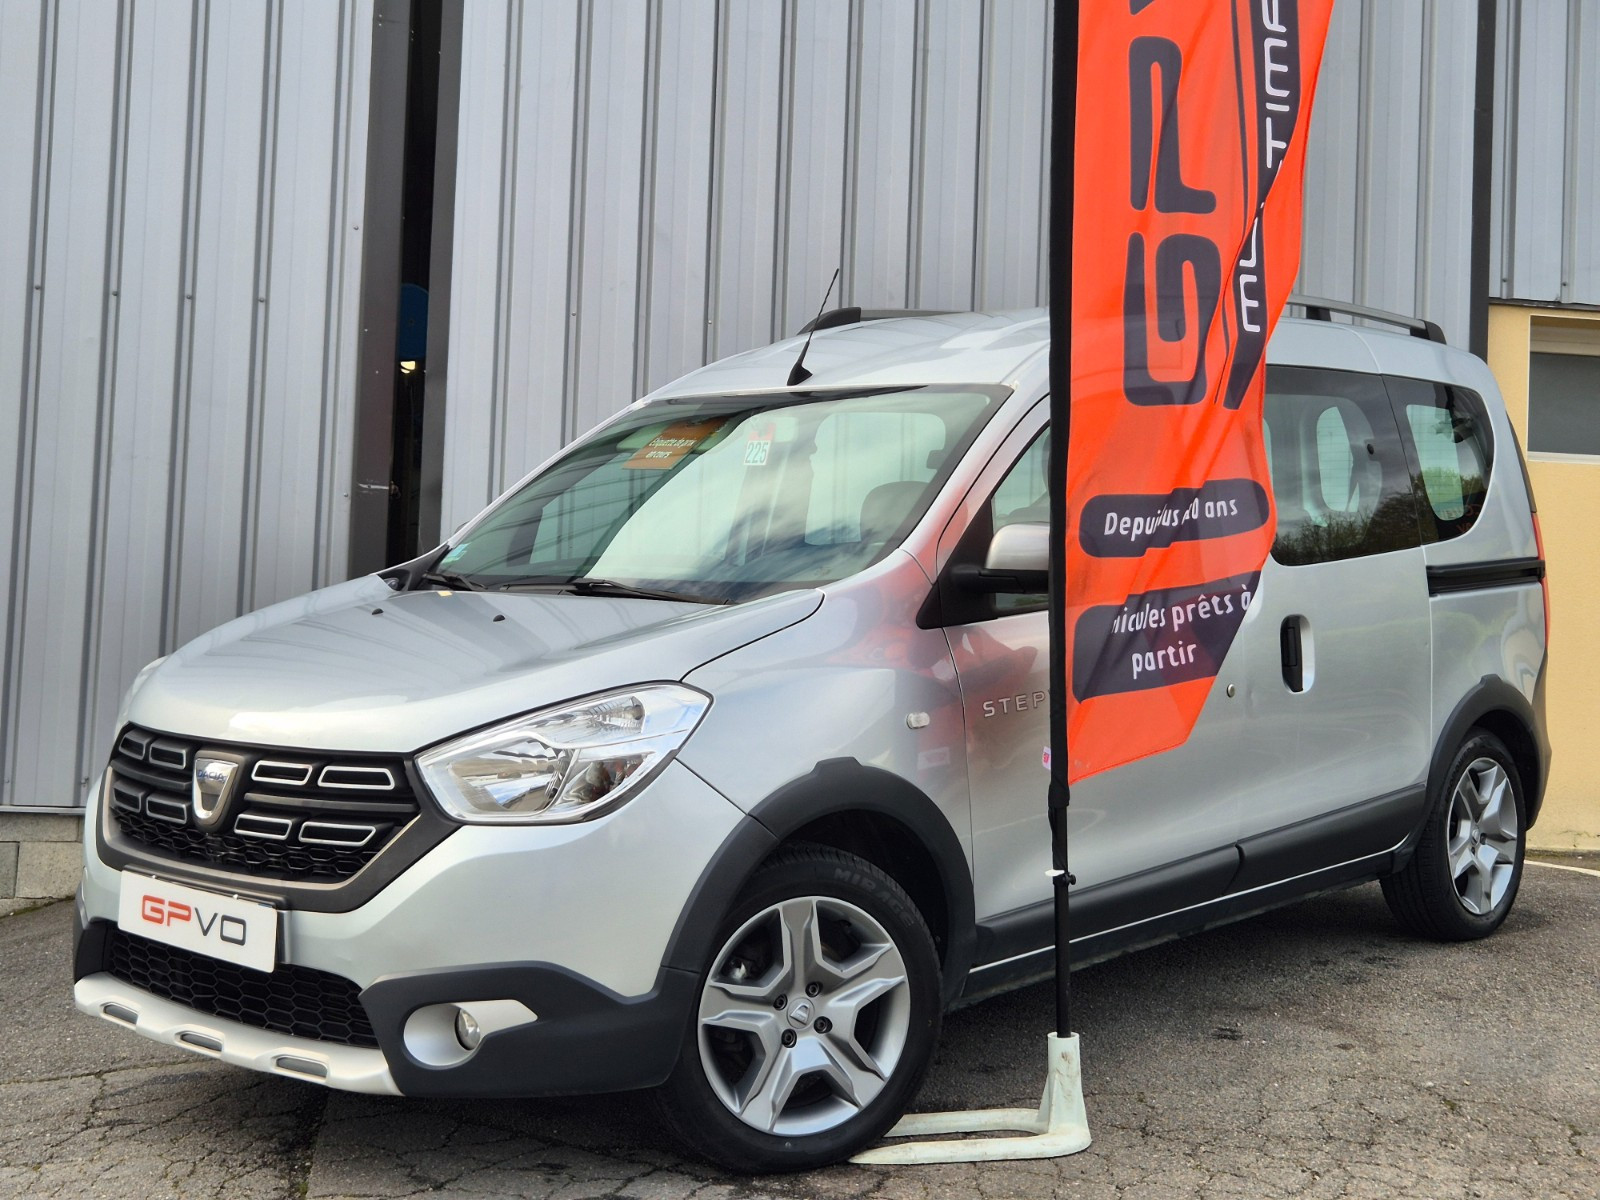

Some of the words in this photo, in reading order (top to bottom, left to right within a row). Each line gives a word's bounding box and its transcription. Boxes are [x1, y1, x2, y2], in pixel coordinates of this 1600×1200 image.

[1123, 0, 1221, 406] GP
[744, 441, 769, 464] 225
[1205, 499, 1238, 518] ans
[1171, 594, 1234, 632] prêts
[1131, 640, 1197, 680] partir
[982, 690, 1048, 717] STEP
[197, 769, 227, 783] DACIA
[141, 894, 247, 946] GPVO
